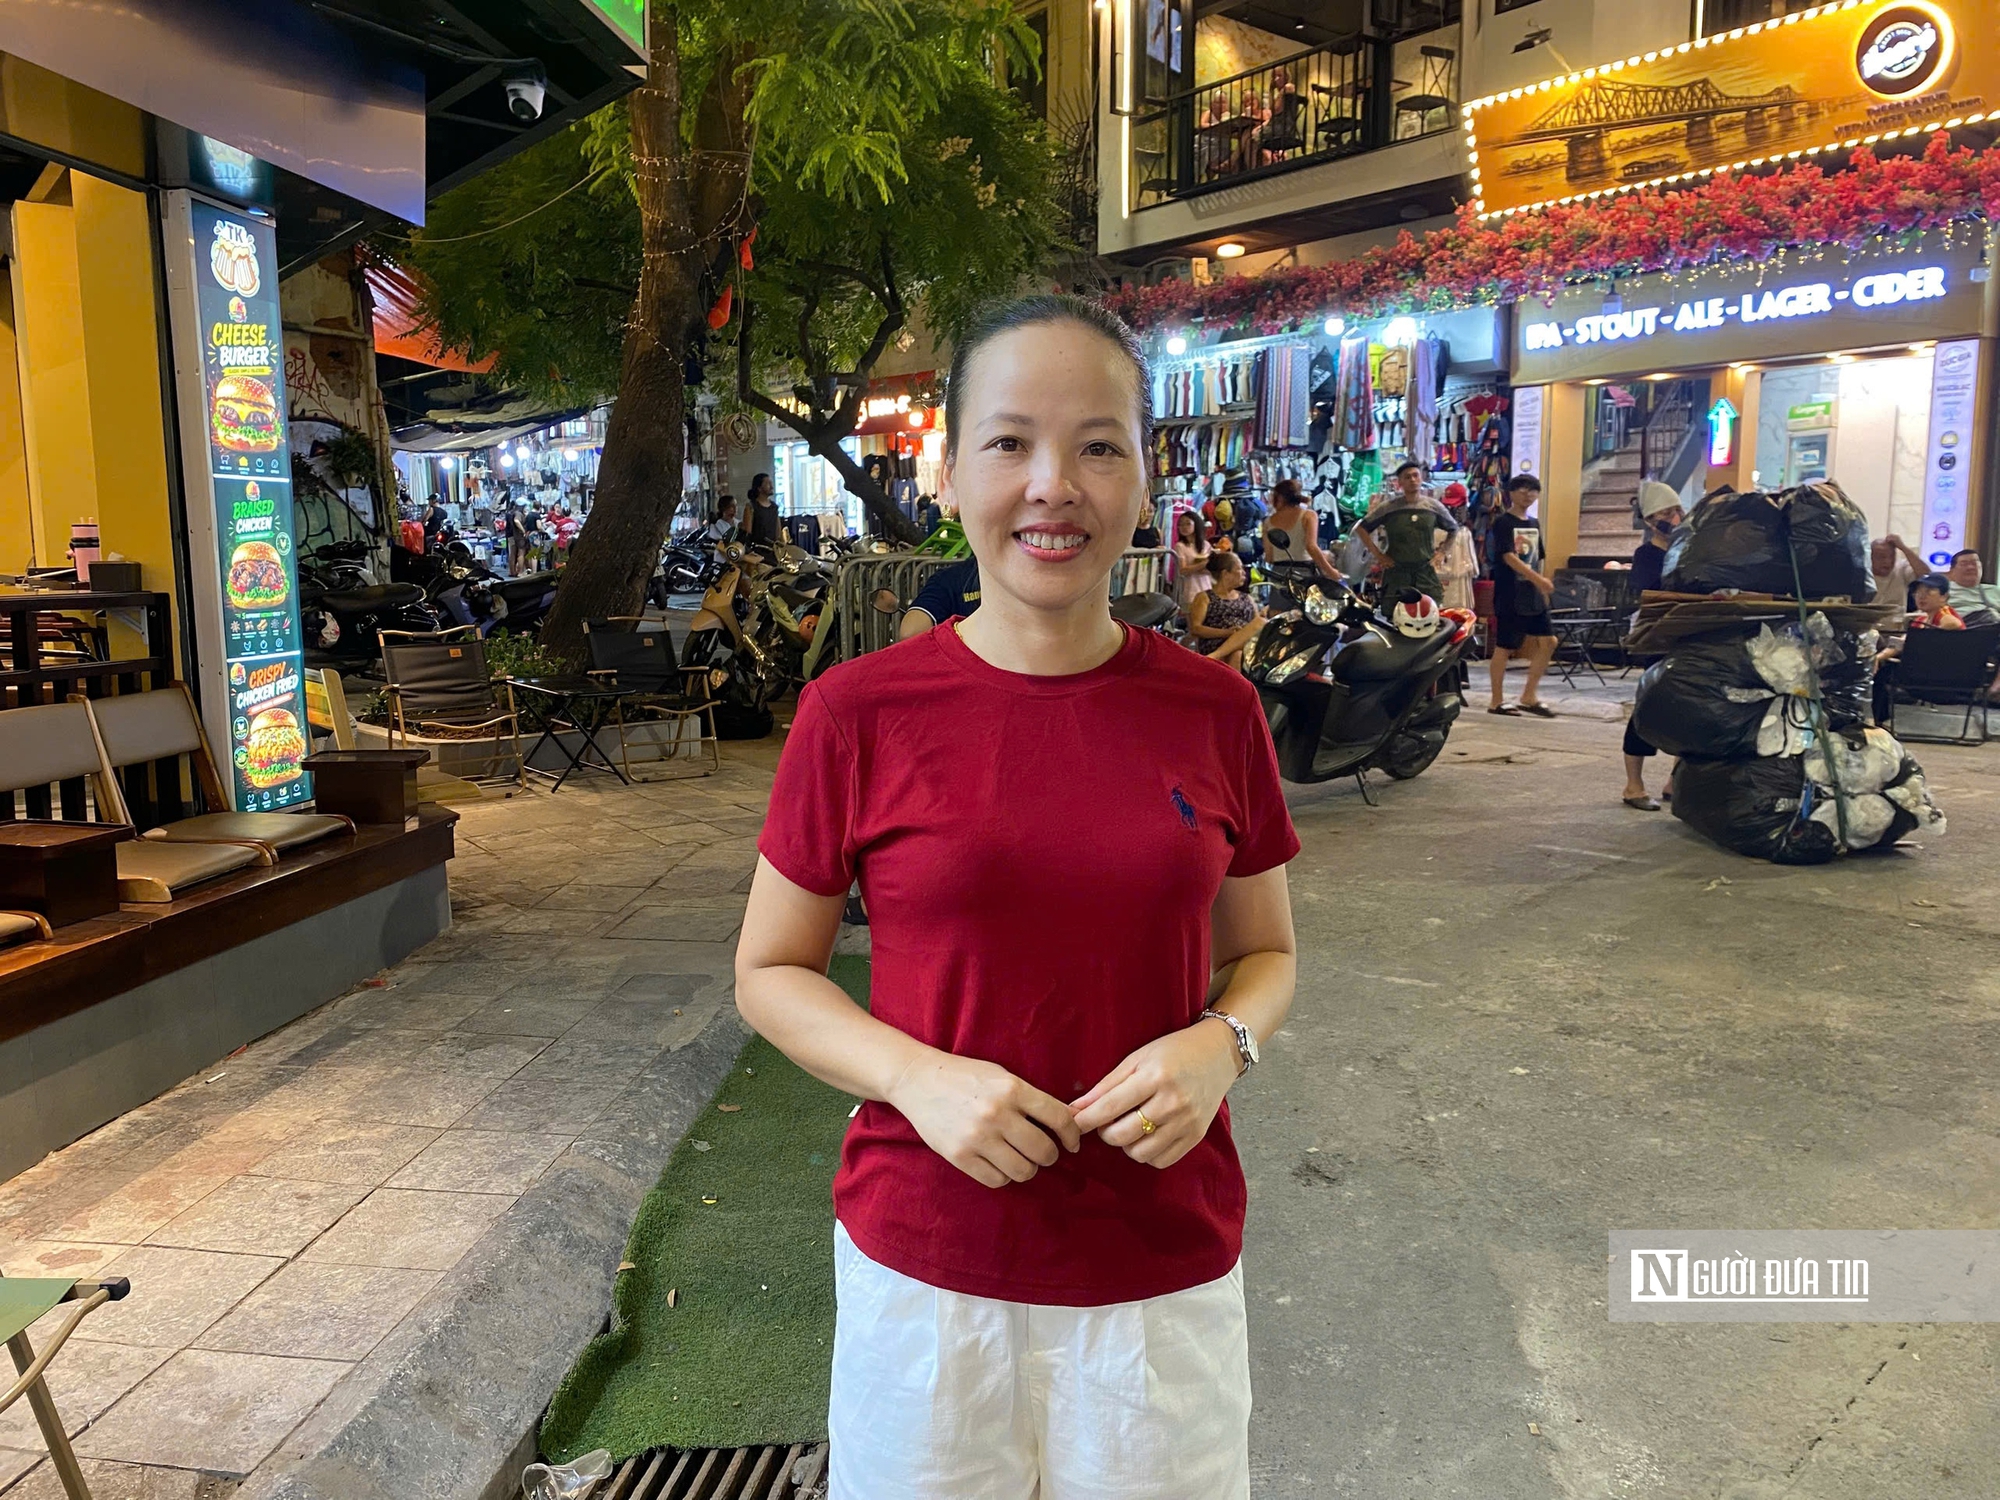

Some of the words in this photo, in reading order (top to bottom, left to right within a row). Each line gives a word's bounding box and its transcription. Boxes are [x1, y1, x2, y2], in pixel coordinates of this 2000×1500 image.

[1950, 96, 1983, 110] BEER
[226, 224, 243, 243] TK
[1575, 307, 1661, 344] STOUT
[1674, 298, 1725, 331] ALE
[1741, 283, 1832, 322] LAGER
[1852, 267, 1946, 307] CIDER
[212, 322, 267, 346] CHEESE
[219, 345, 270, 367] BURGER
[232, 499, 275, 520] BRAISED
[235, 516, 273, 534] CHICKEN
[963, 590, 982, 603] Han
[248, 661, 287, 689] CRISPY
[236, 682, 276, 709] CHICKEN
[275, 673, 299, 697] FRIED
